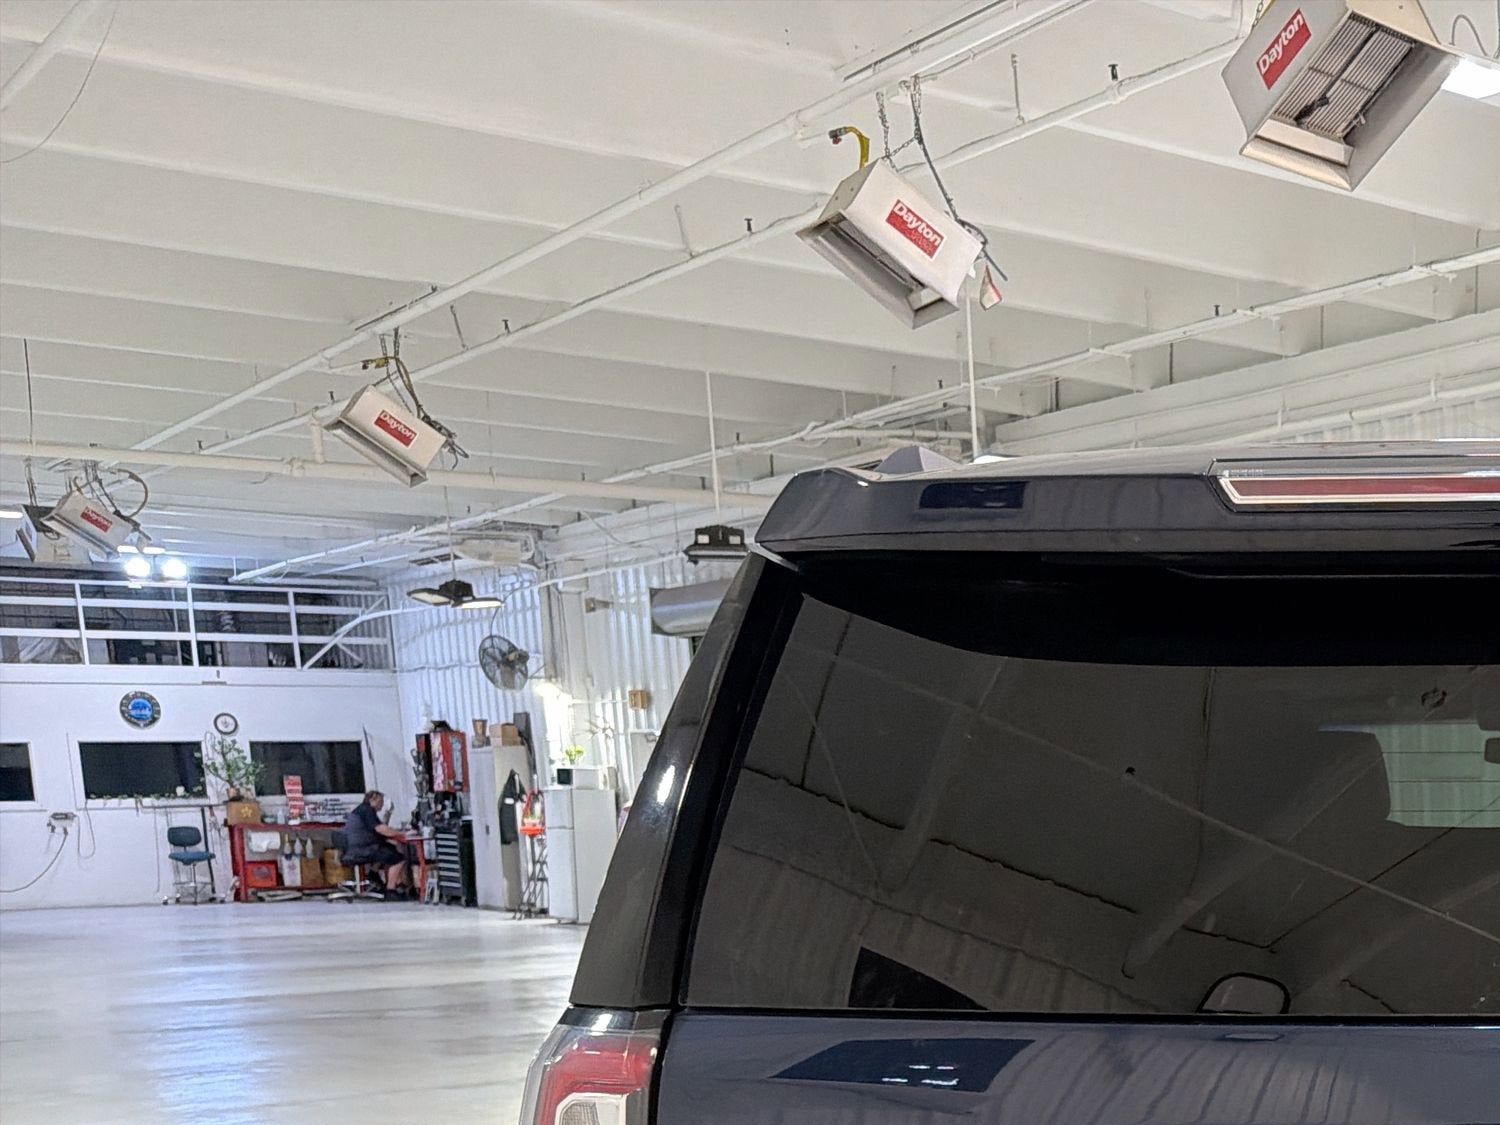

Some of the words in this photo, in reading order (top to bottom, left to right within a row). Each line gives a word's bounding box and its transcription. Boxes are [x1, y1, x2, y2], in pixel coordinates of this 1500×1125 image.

[1259, 14, 1304, 75] Dayton
[893, 202, 942, 247] Dayton
[380, 411, 416, 440] Dayton
